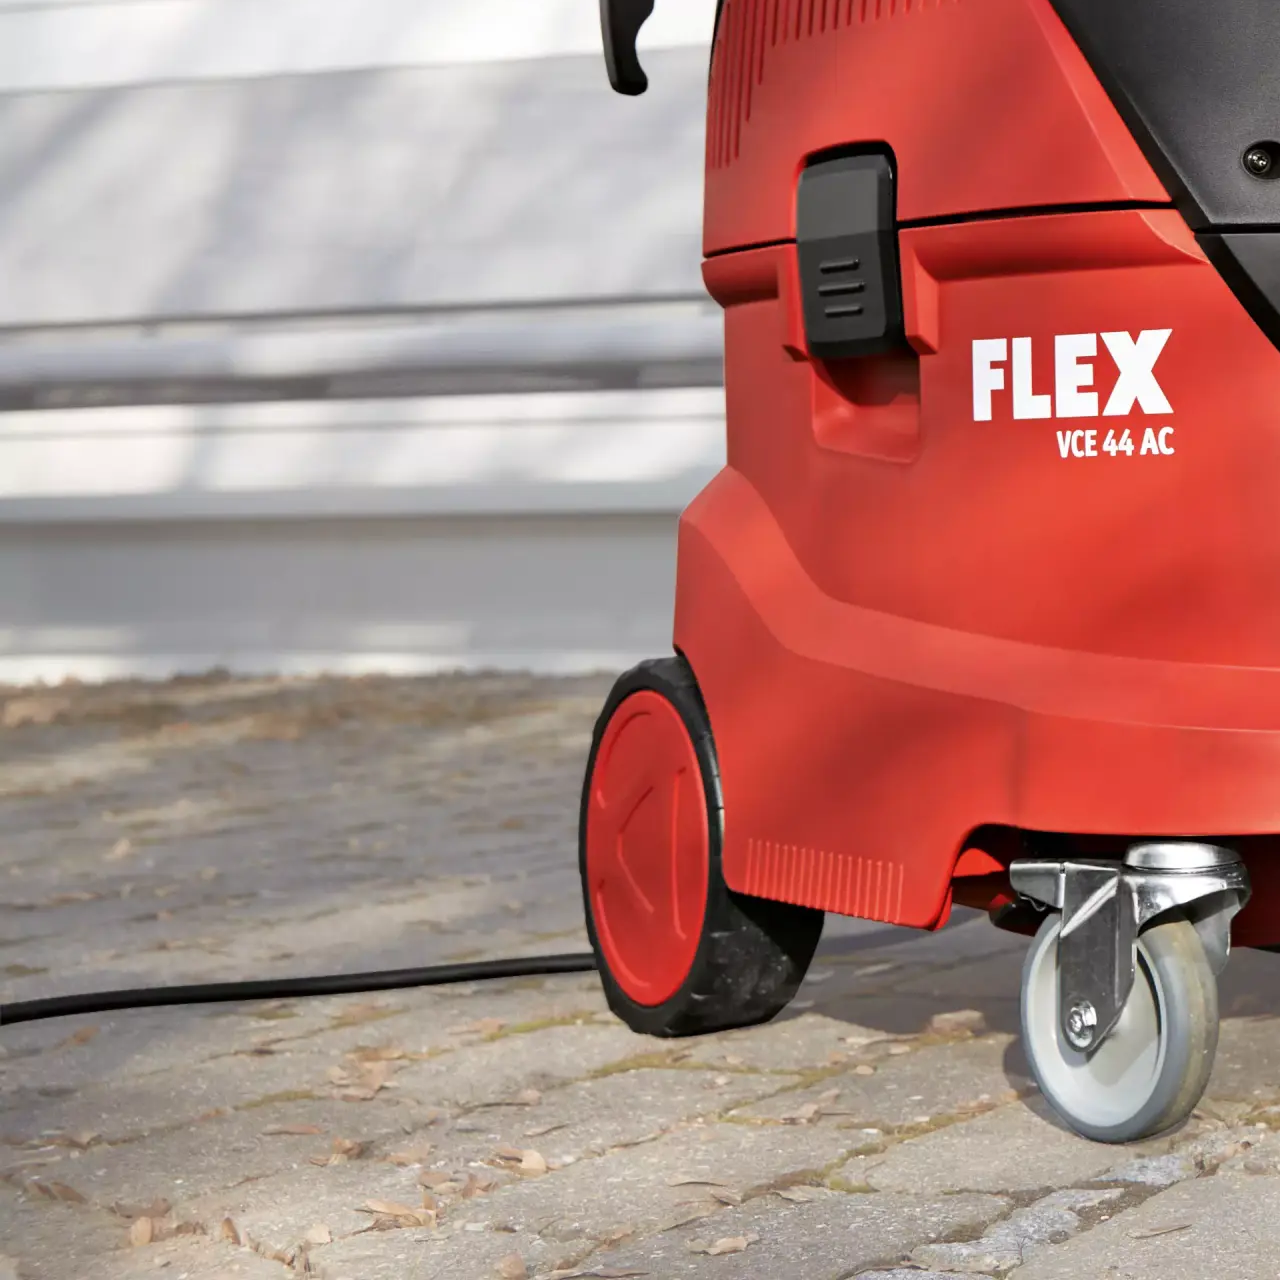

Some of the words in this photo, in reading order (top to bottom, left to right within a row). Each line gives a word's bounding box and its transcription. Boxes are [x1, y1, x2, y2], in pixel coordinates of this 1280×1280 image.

[972, 328, 1174, 421] FLEX
[1056, 429, 1098, 458] VCE
[1102, 428, 1135, 456] 44
[1140, 426, 1175, 455] AC
